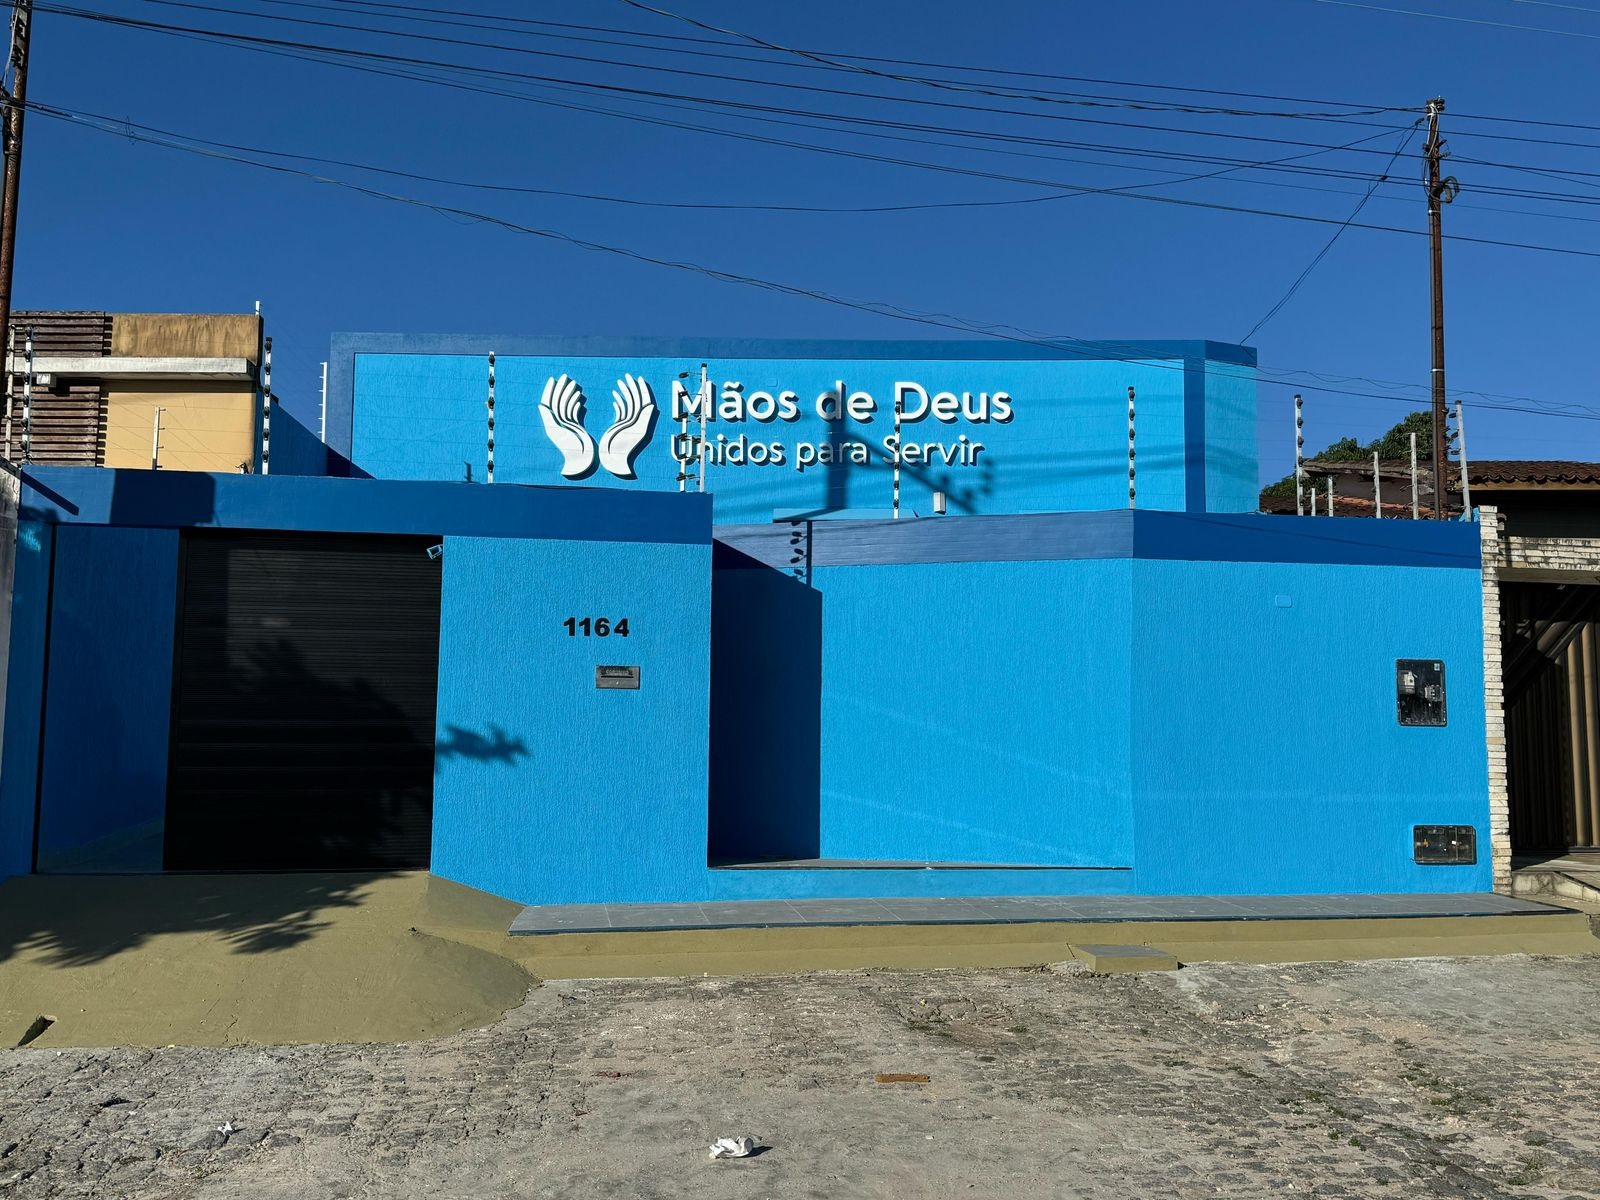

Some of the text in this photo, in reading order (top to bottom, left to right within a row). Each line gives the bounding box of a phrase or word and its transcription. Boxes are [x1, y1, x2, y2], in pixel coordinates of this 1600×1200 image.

[671, 379, 1012, 421] Mãos de Deus
[670, 433, 982, 470] Unidos para Servir
[563, 616, 630, 638] 1164
